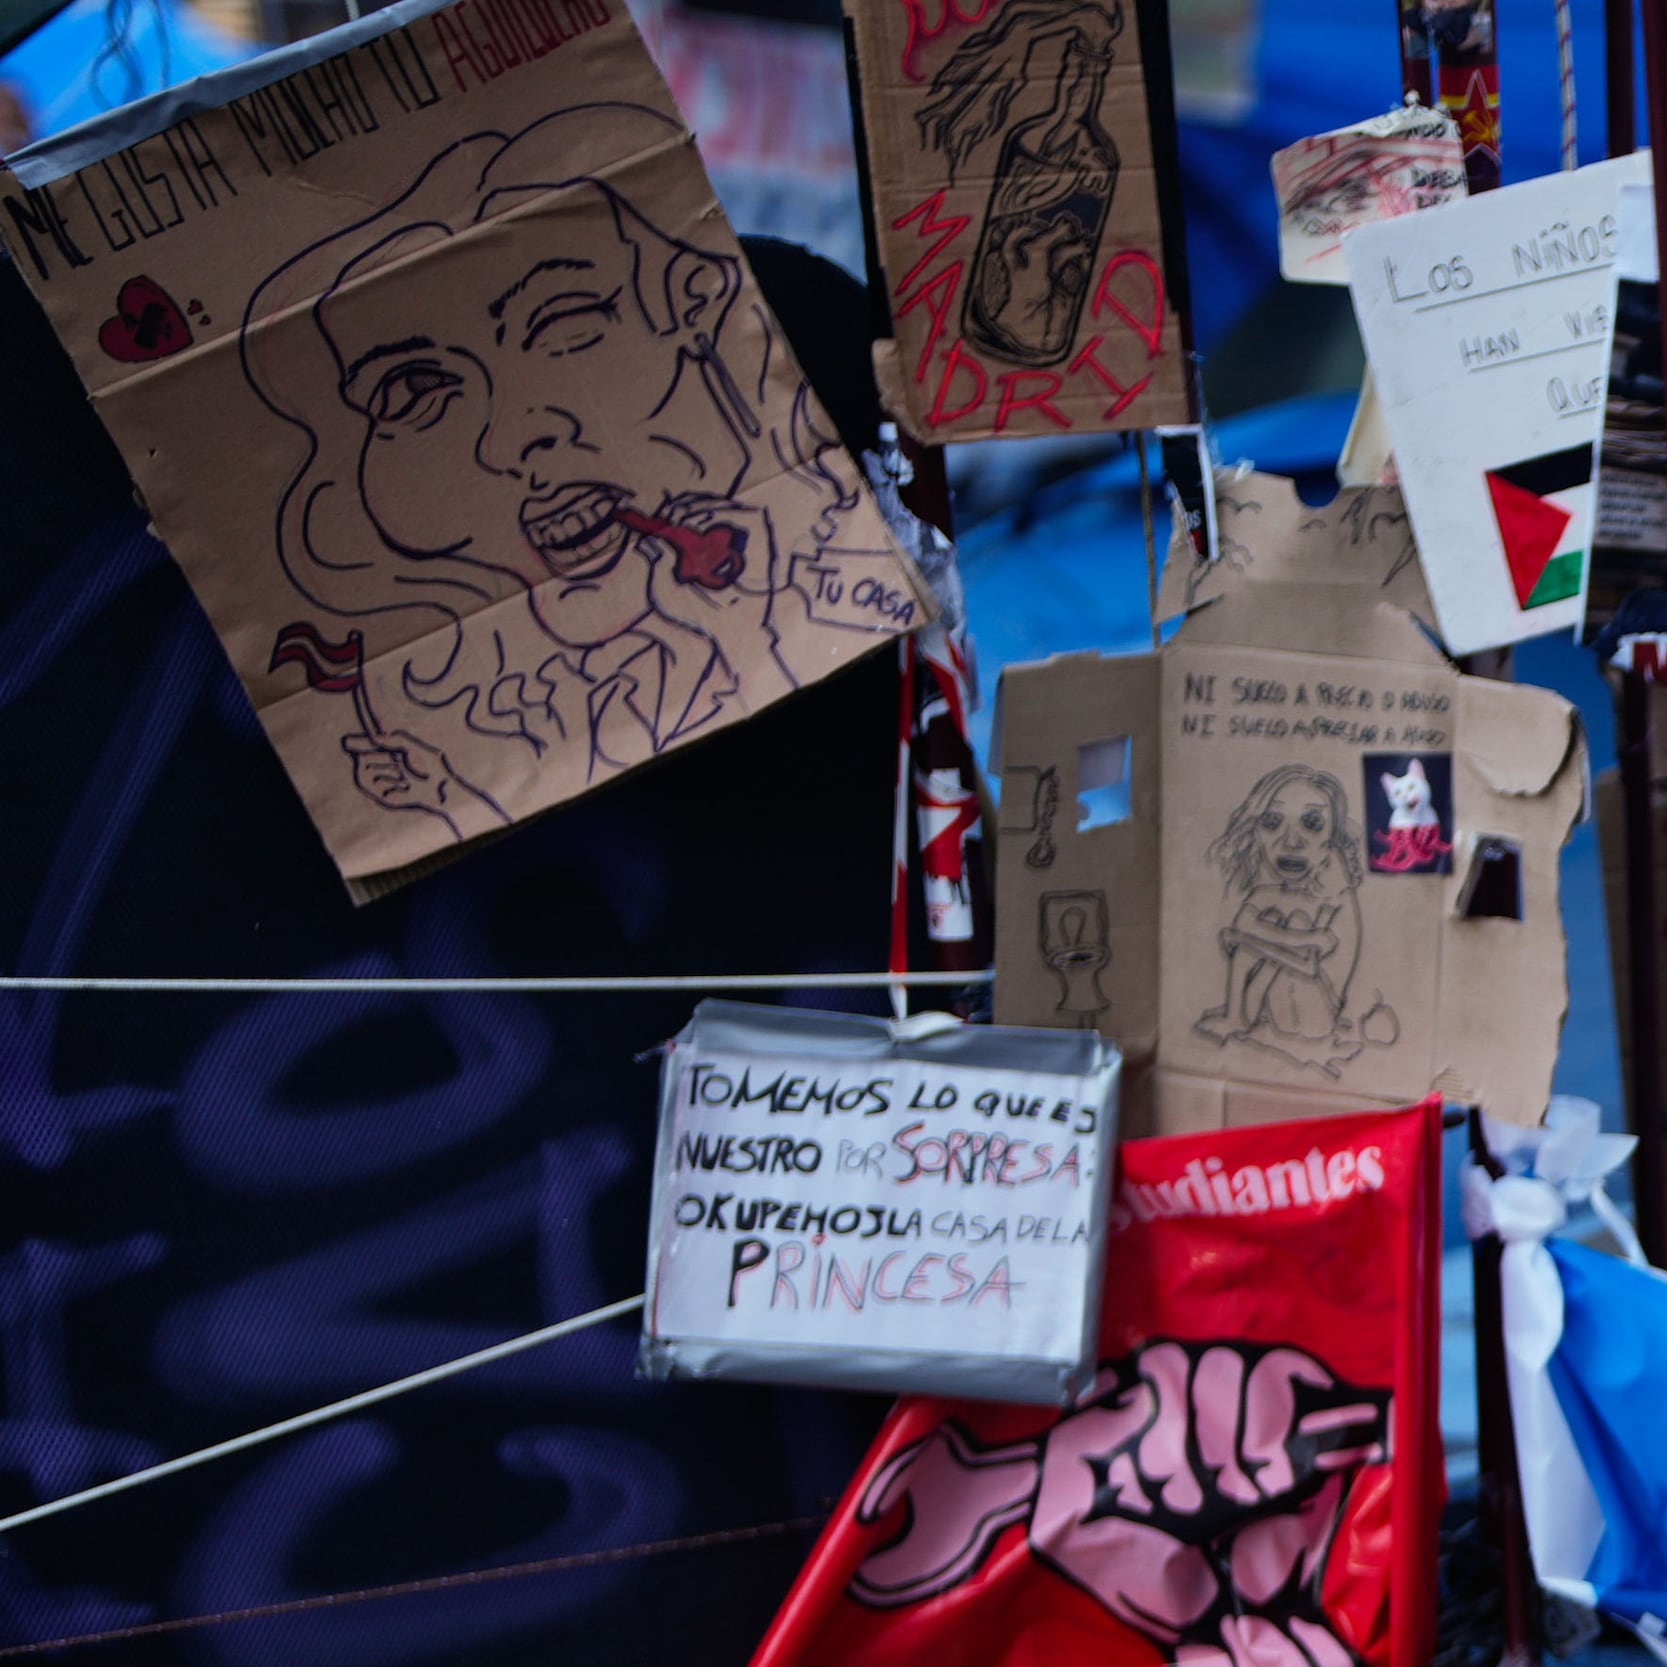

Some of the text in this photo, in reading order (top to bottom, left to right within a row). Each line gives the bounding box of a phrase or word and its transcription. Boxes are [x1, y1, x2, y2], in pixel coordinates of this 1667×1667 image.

[1384, 255, 1474, 304] LOS
[1459, 328, 1520, 368] HAN
[806, 566, 917, 625] TU CASA
[686, 1063, 891, 1116] TOMEMOS
[906, 1079, 958, 1112] LO
[675, 1135, 887, 1175] NUESTRO POR
[930, 1210, 1008, 1242] CASA
